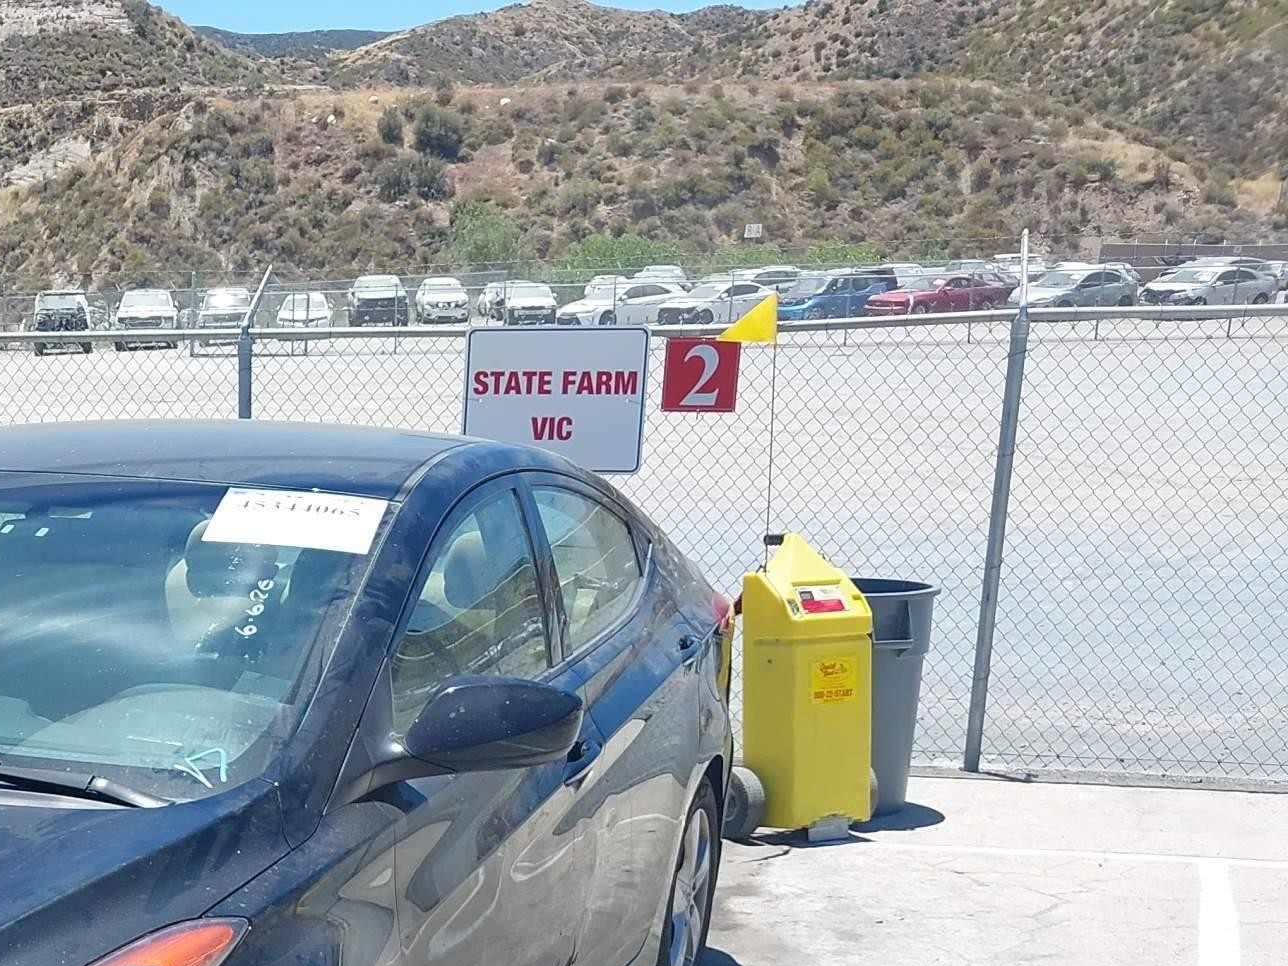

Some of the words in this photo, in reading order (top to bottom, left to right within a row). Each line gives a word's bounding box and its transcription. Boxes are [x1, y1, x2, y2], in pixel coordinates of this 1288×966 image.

[473, 371, 552, 395] STATE
[561, 371, 637, 395] FARM
[680, 344, 720, 406] 2
[531, 416, 573, 441] VIC
